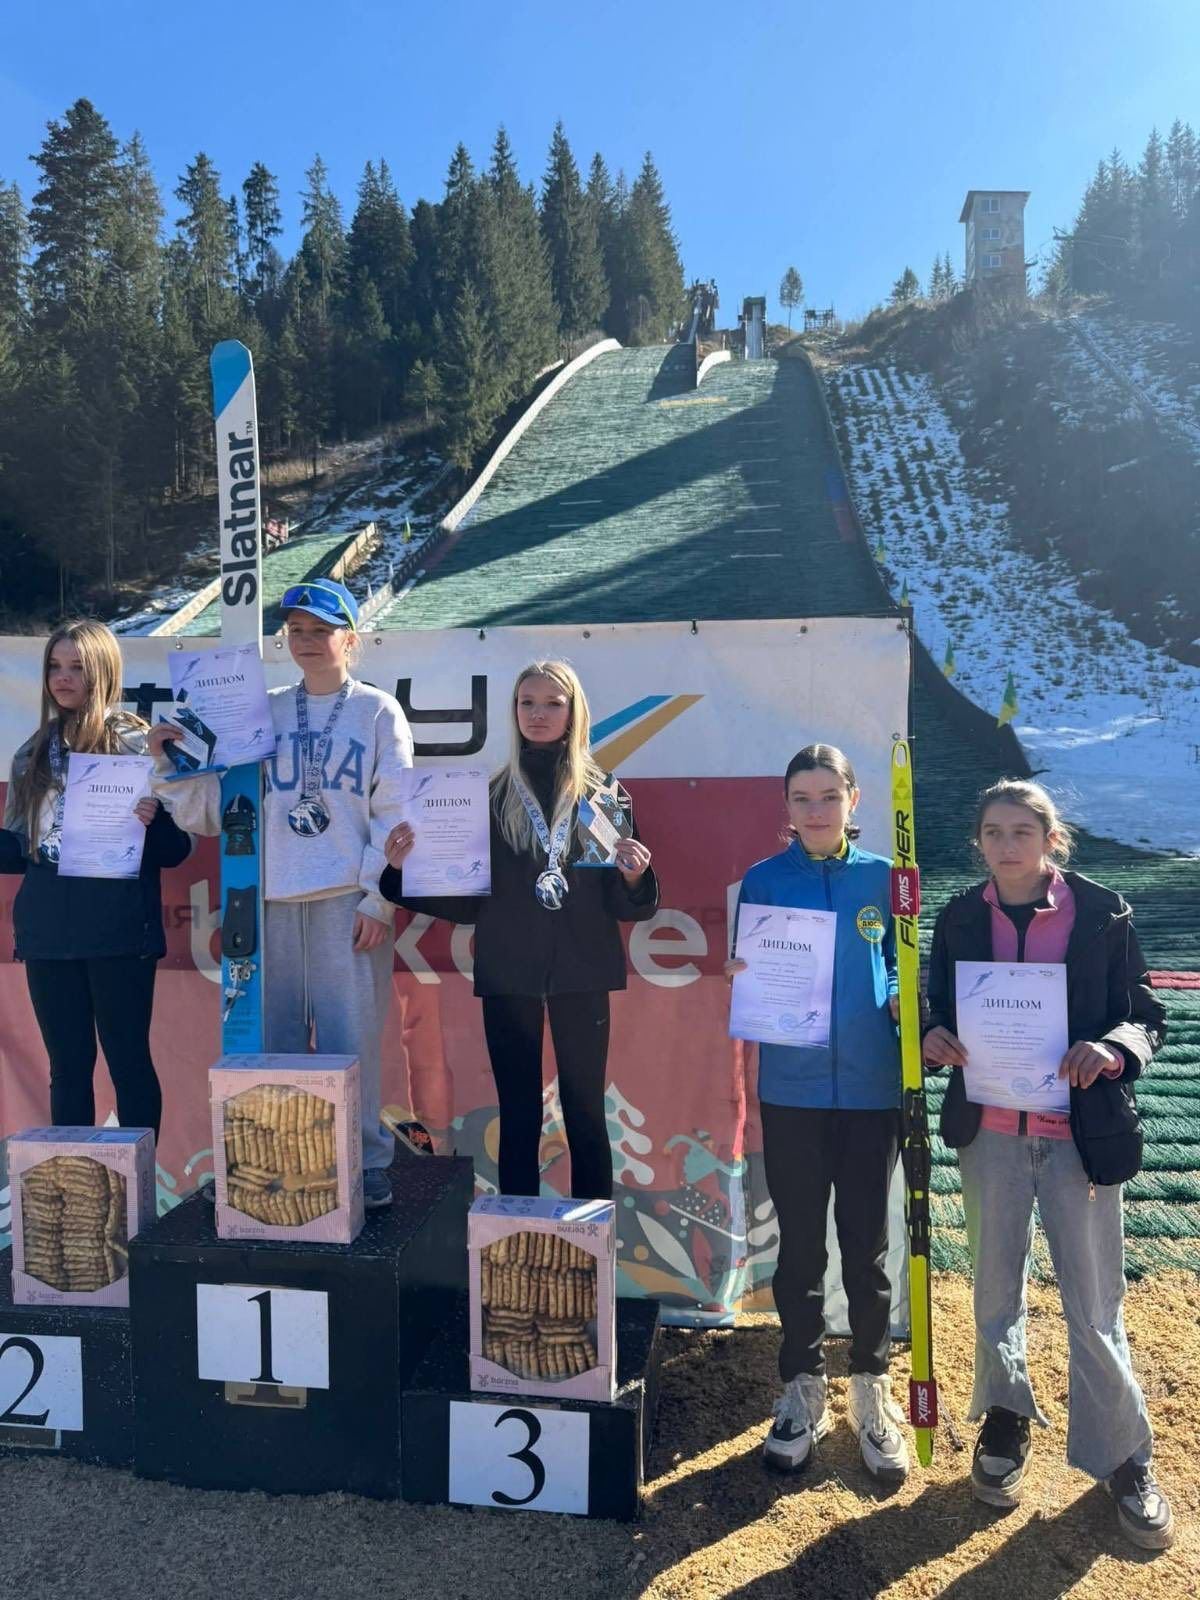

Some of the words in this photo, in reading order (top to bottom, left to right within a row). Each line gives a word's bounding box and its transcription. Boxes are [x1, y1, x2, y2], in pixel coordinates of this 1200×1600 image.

[222, 431, 257, 607] Slatnar
[194, 673, 245, 688] ДИПЛОМ
[87, 784, 135, 795] ДИПЛОМ
[266, 731, 366, 797] URA
[422, 798, 472, 808] ДИПЛОМ
[896, 810, 915, 949] FIHER
[758, 938, 812, 953] ДИПЛОМ
[981, 998, 1042, 1010] ДИПЛОМ
[247, 1290, 284, 1385] 1
[0, 1336, 51, 1427] 2
[491, 1408, 546, 1506] 3
